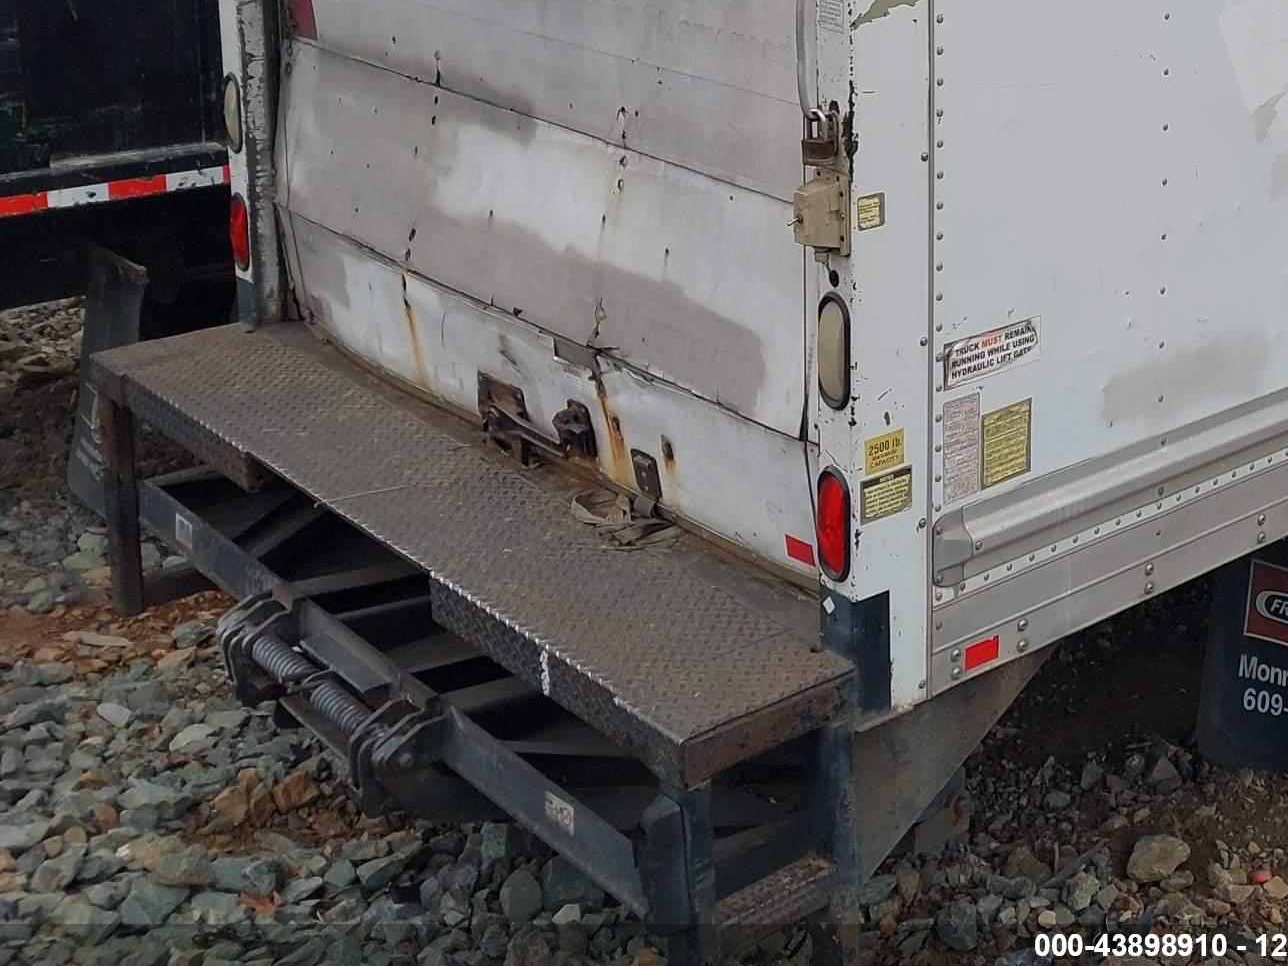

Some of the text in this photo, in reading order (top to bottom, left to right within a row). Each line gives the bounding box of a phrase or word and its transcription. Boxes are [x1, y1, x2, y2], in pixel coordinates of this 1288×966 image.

[951, 334, 1035, 370] RUNNING WHILE USING
[954, 342, 980, 357] TRUCK
[981, 335, 1003, 349] MUST
[951, 358, 995, 380] HYDRAULIC
[996, 353, 1012, 365] LIFT
[868, 439, 890, 457] 2500
[870, 454, 899, 469] CAPACITY
